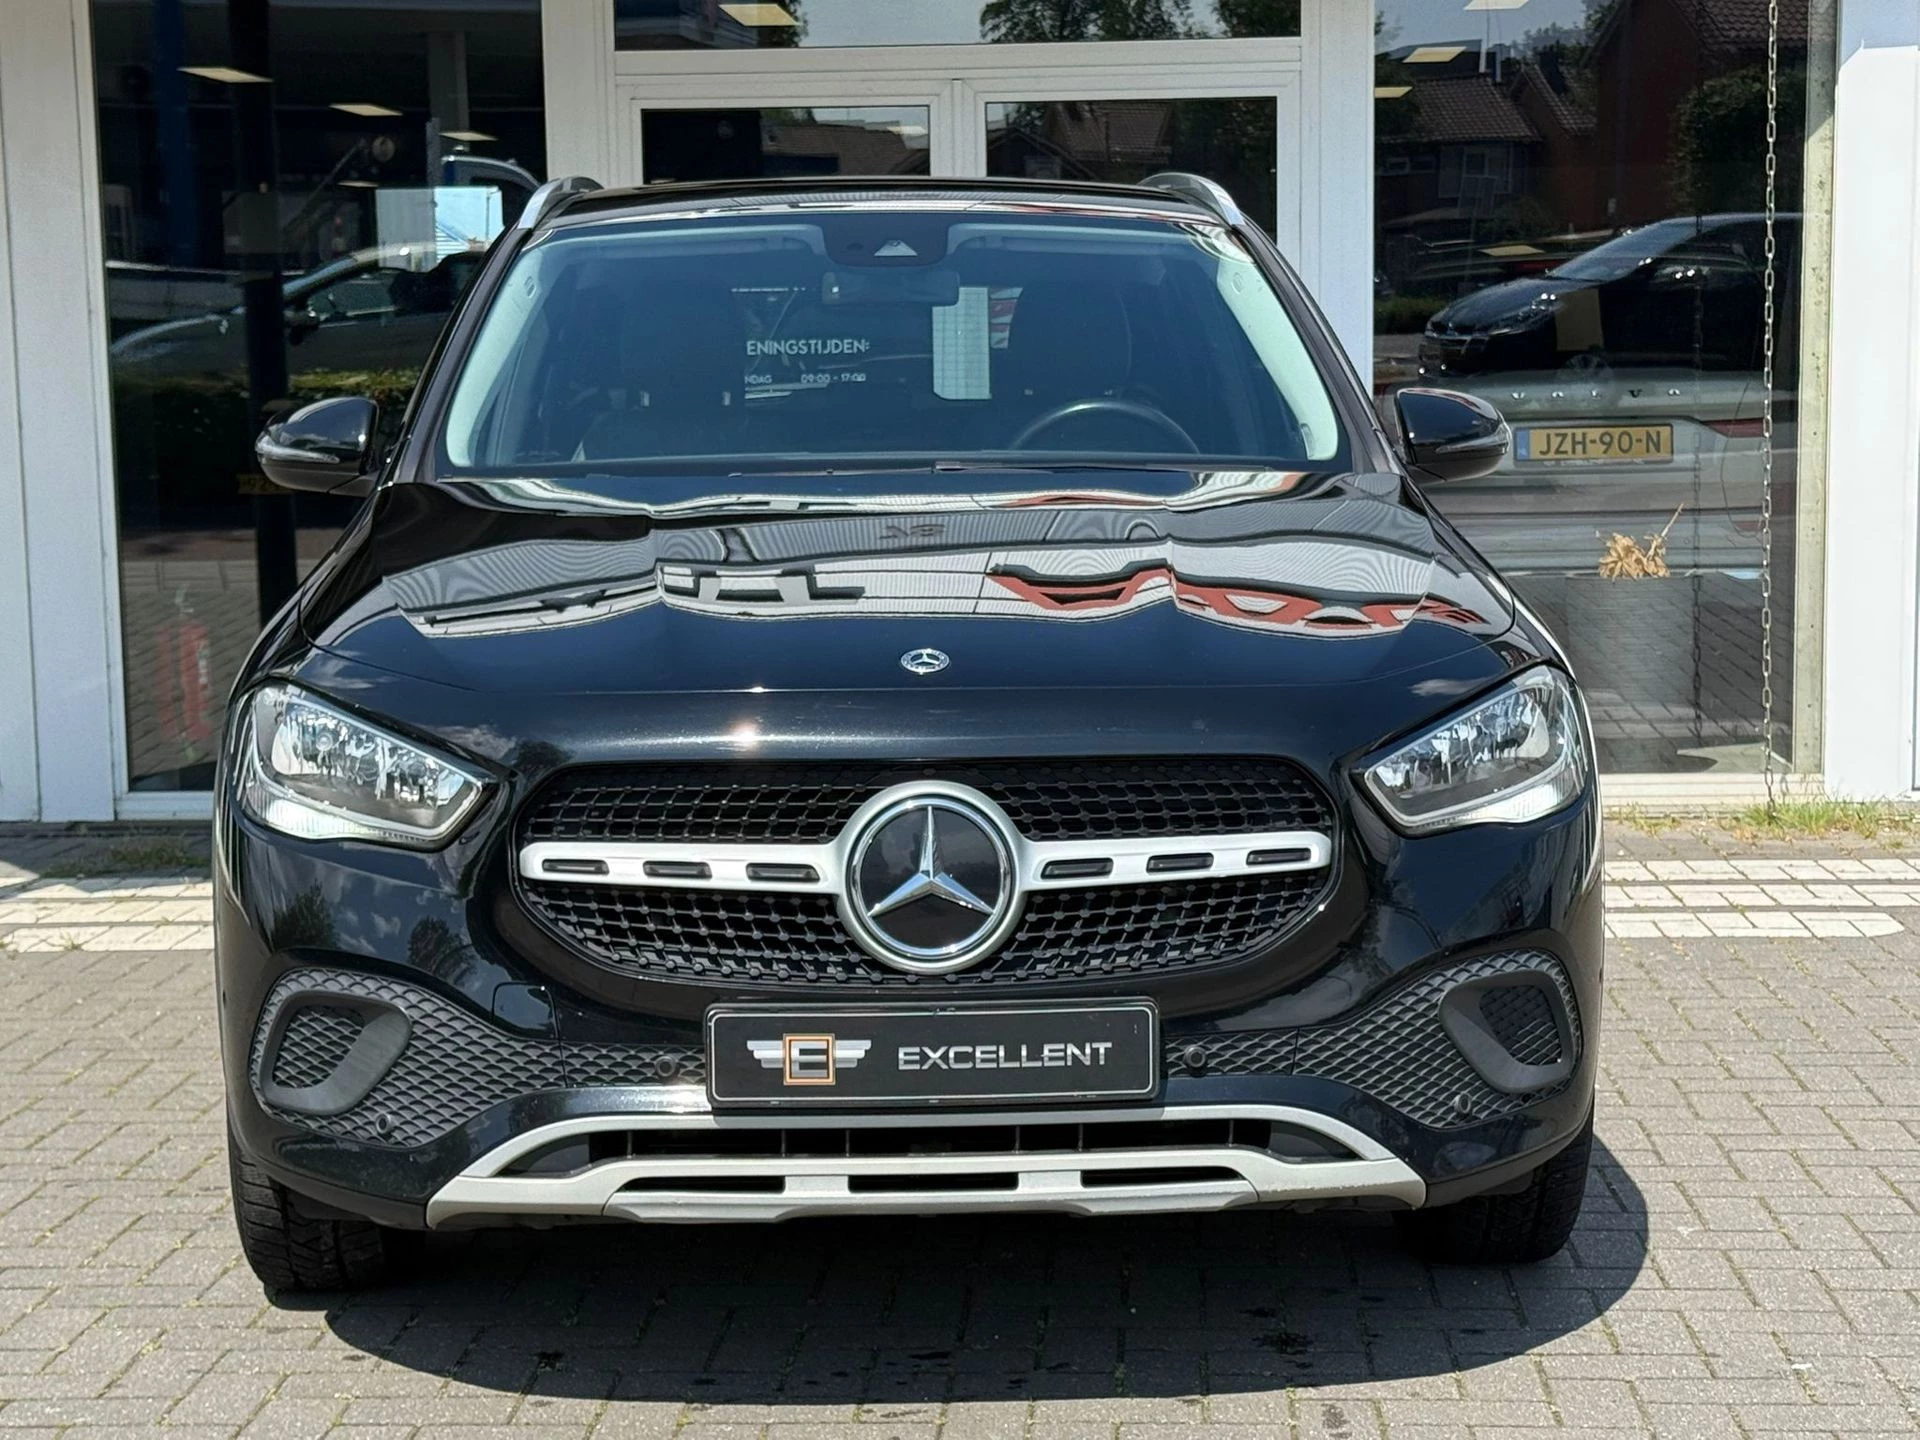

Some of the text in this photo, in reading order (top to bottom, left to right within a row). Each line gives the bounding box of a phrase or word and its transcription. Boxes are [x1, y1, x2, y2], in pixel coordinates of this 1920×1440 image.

[801, 373, 831, 384] 09:00
[1539, 430, 1661, 456] JZH-90-N
[898, 1041, 1113, 1071] EXCELLENT
